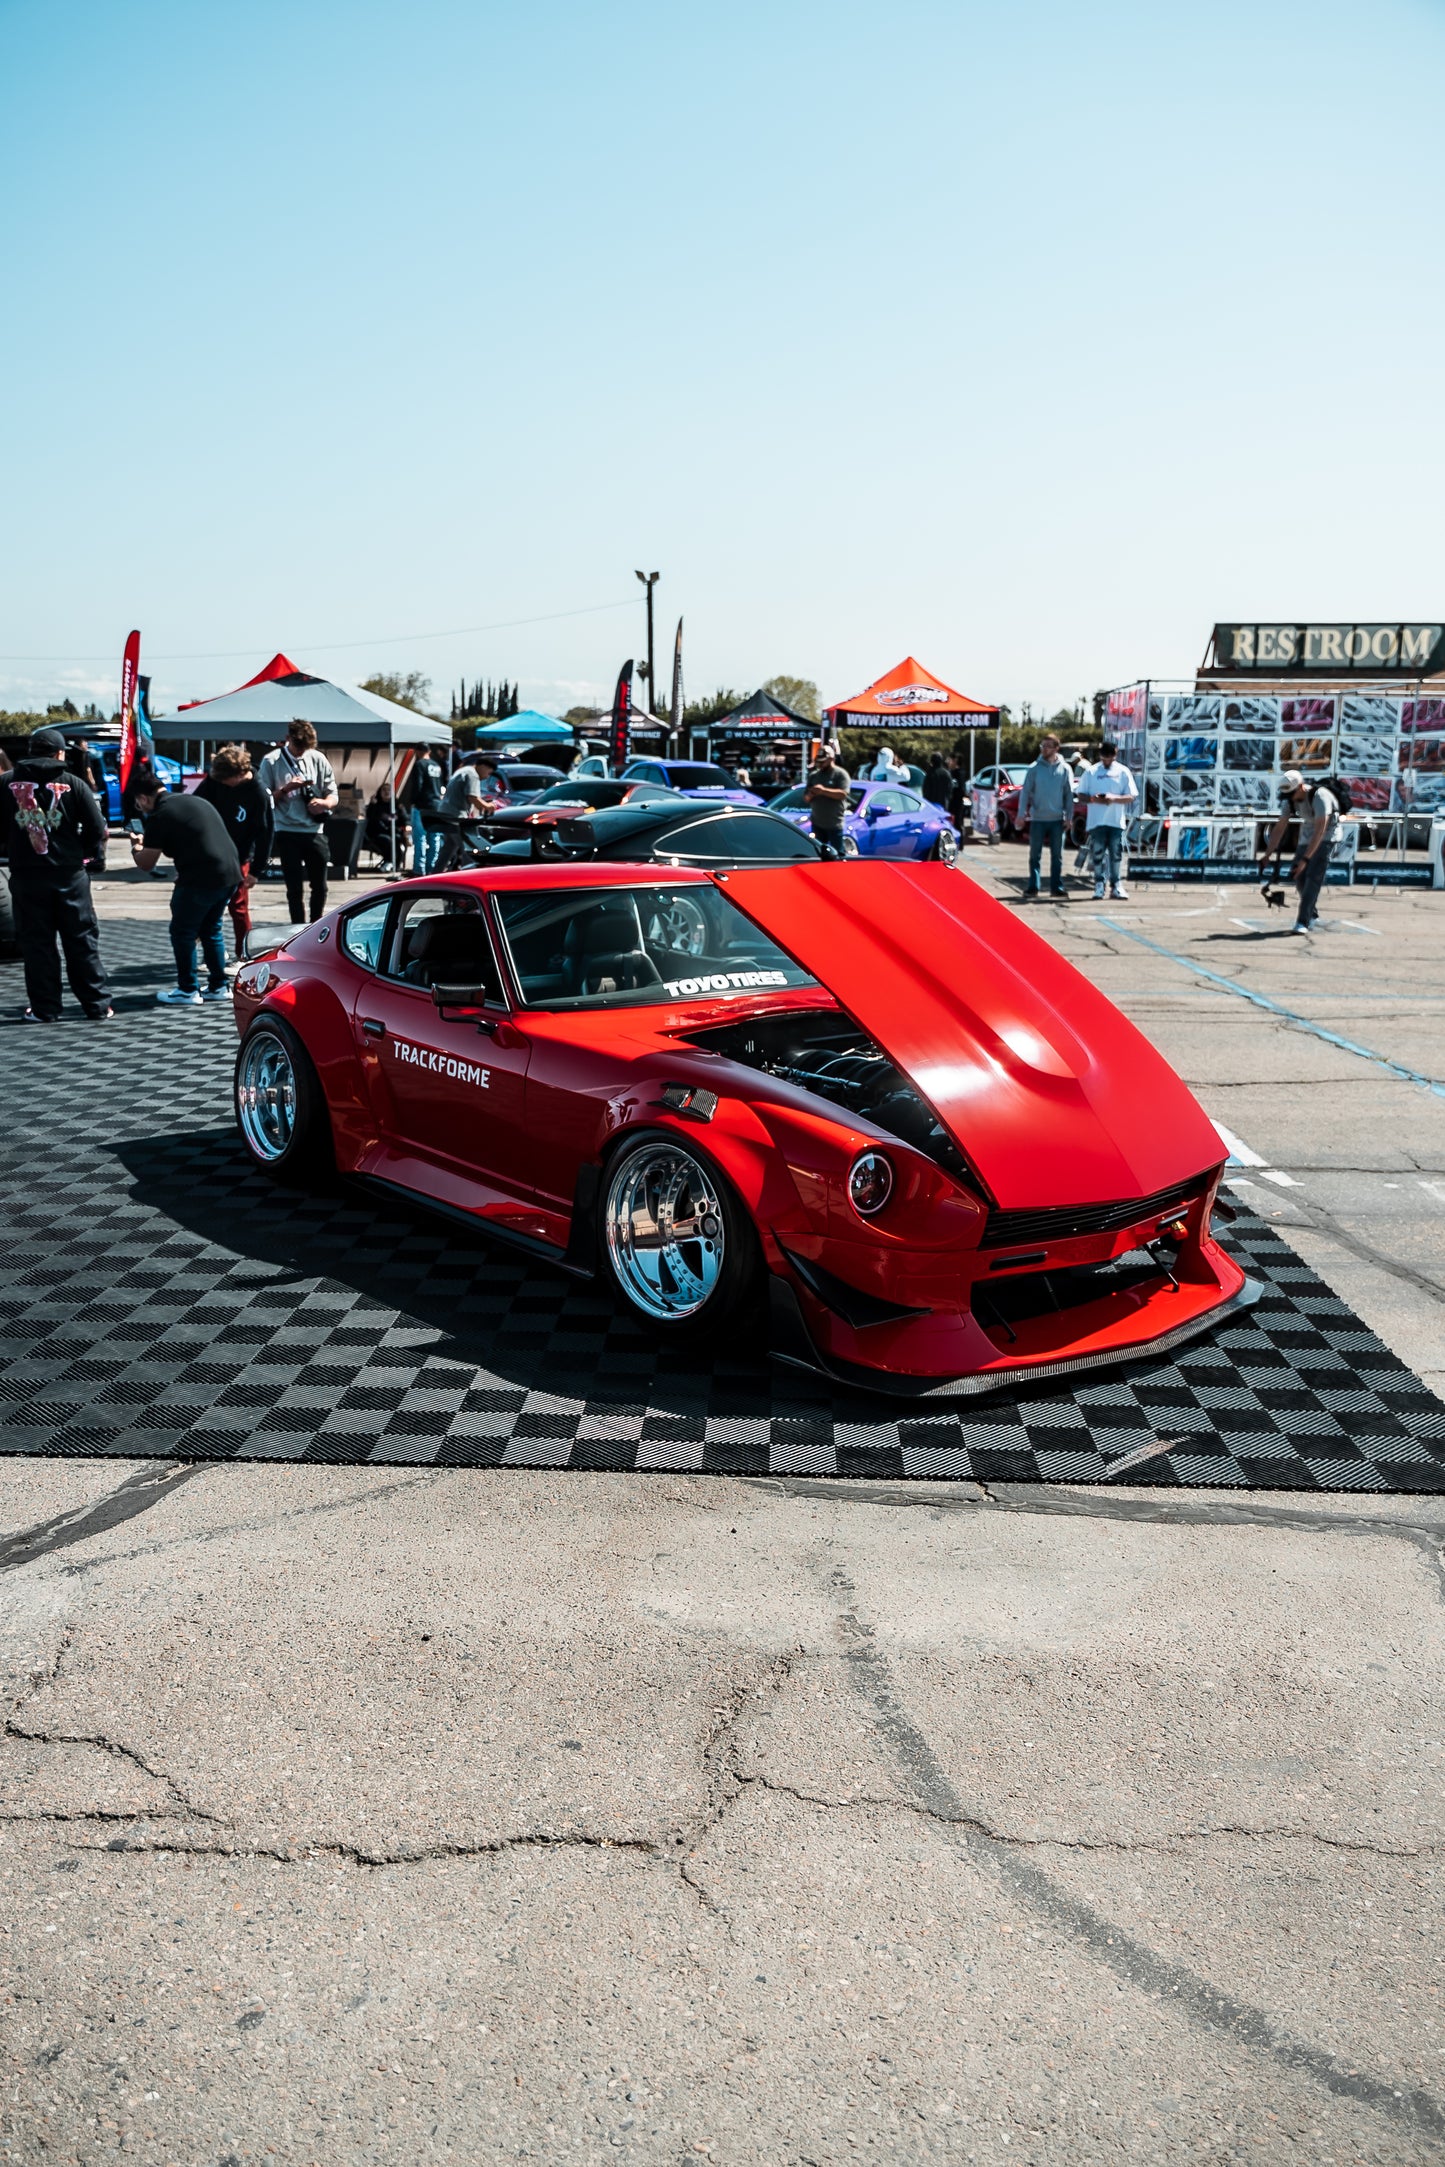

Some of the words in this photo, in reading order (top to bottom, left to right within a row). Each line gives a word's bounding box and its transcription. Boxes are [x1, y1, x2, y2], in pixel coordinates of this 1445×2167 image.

[1231, 628, 1433, 661] RESTROOM
[847, 713, 989, 728] WWW.PRESSSTARTUS.COM
[393, 1040, 491, 1089] TRACKFORME
